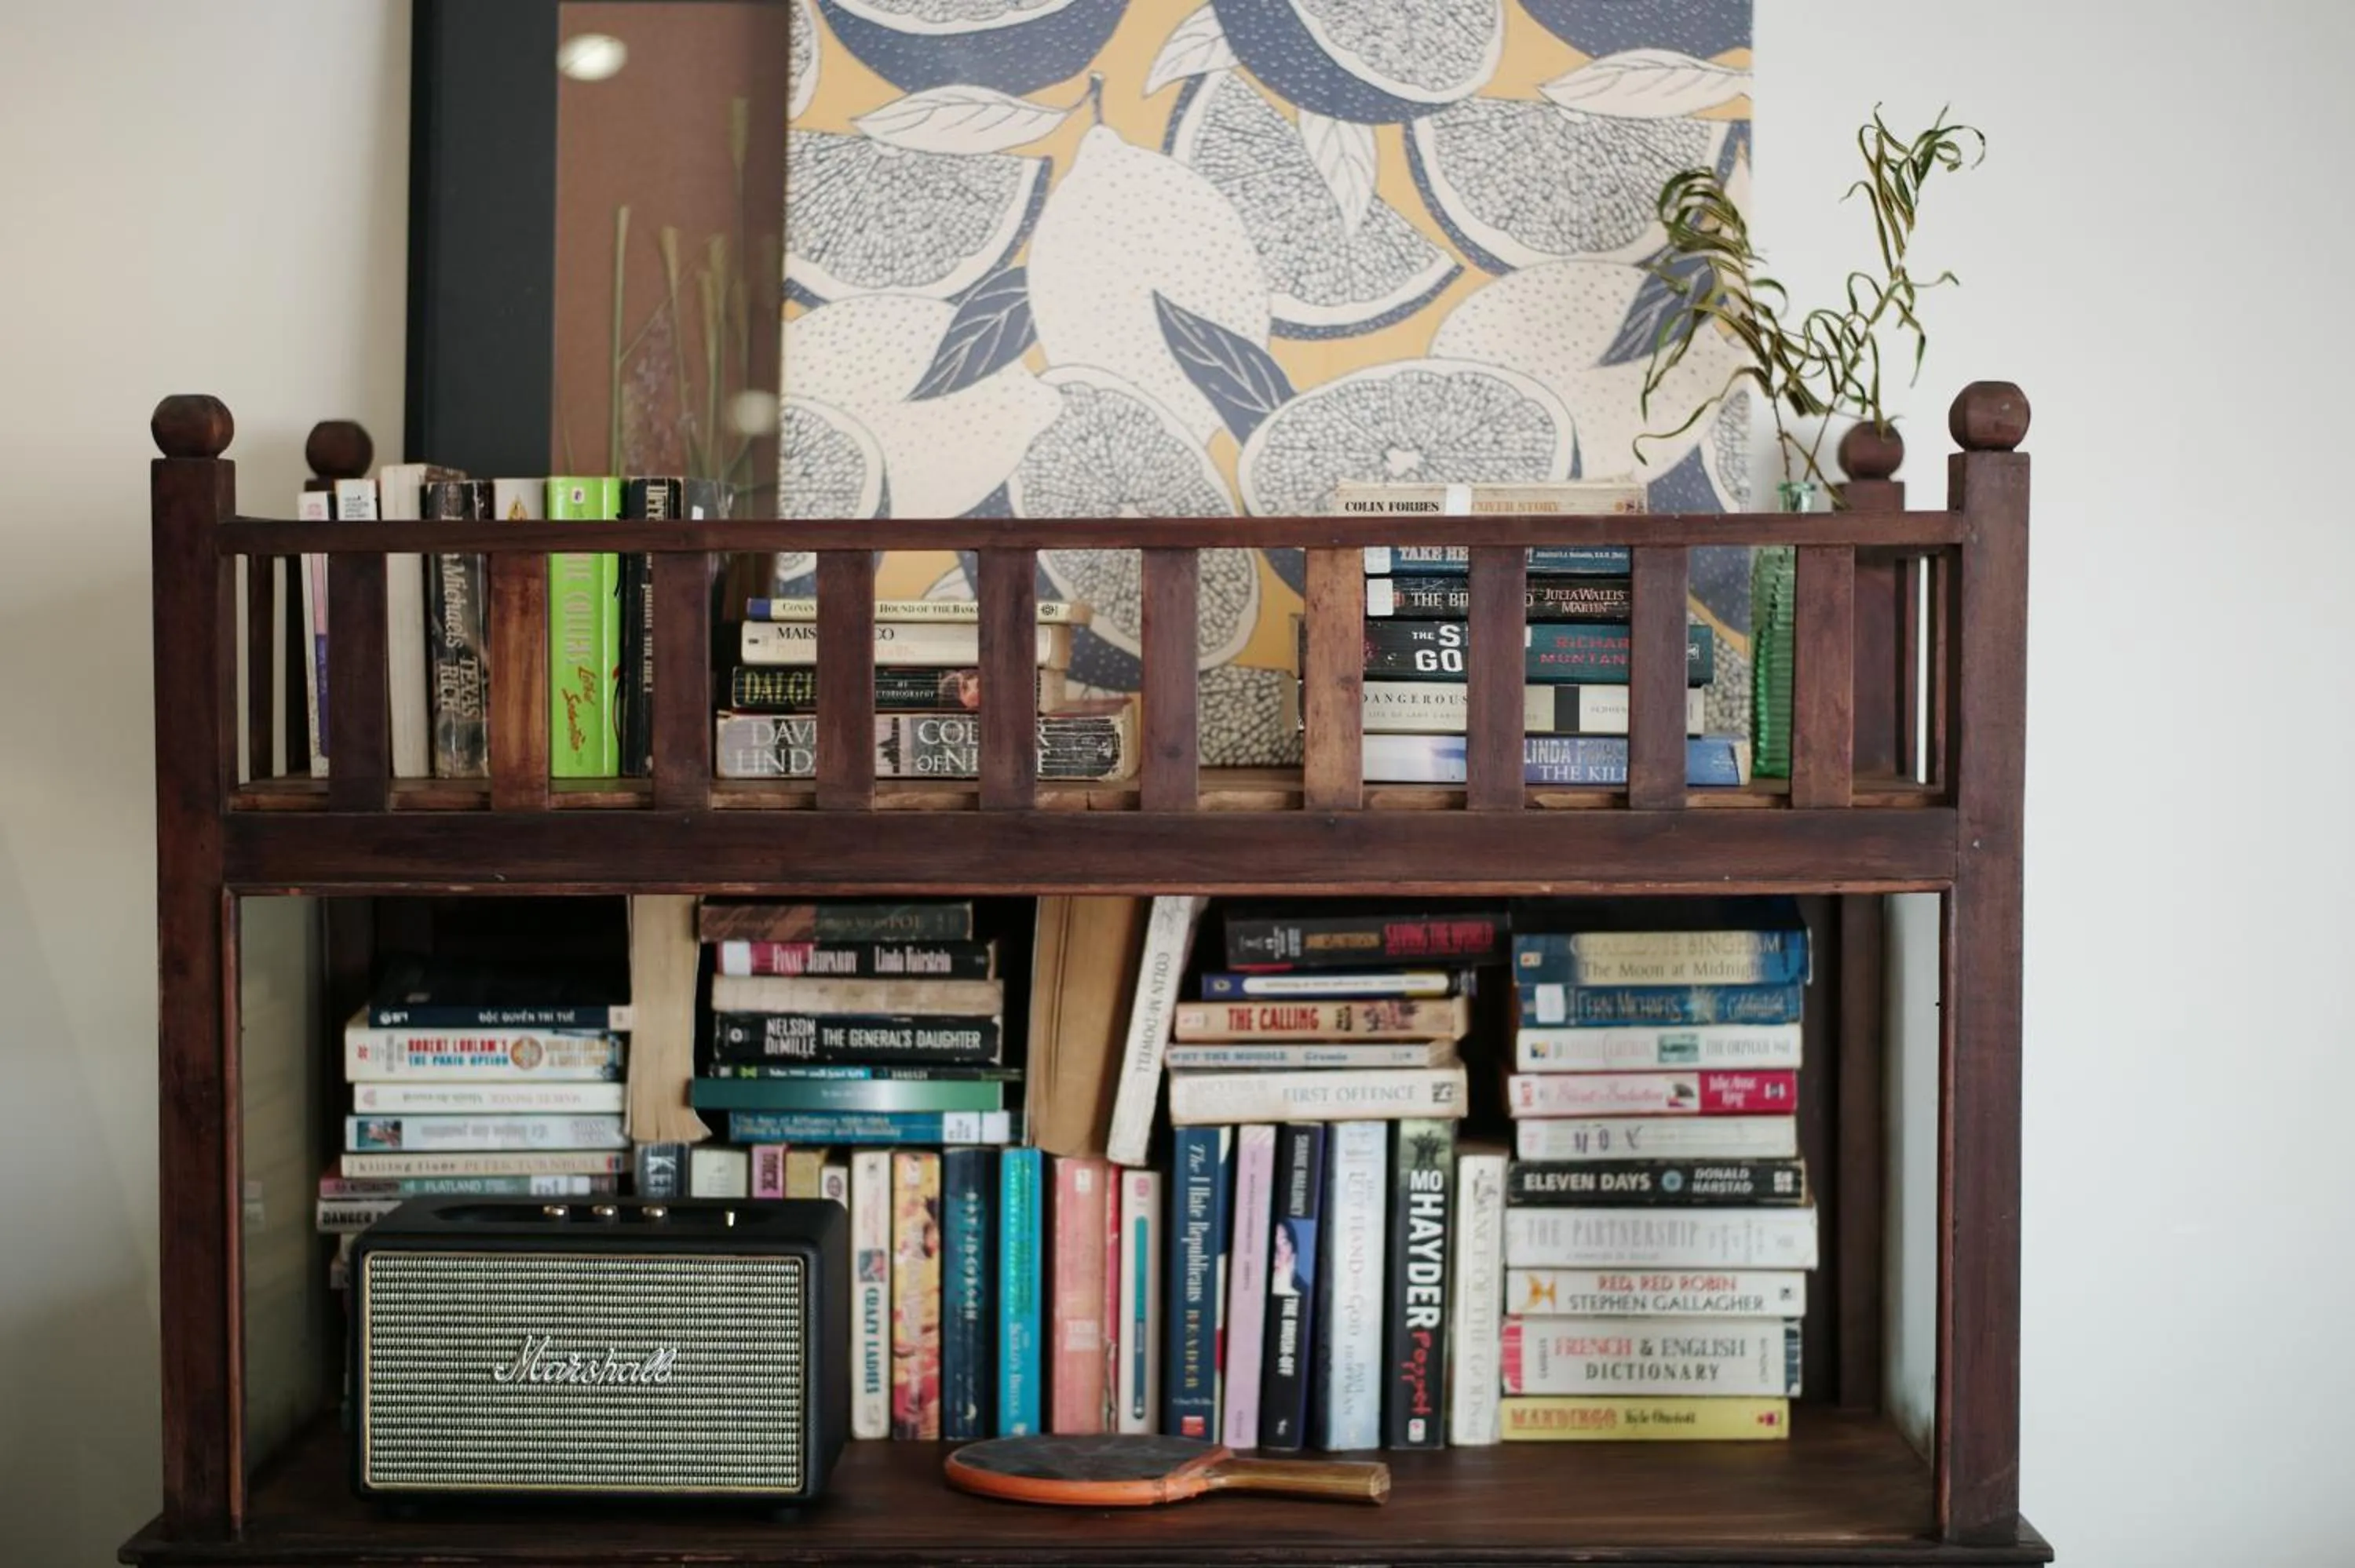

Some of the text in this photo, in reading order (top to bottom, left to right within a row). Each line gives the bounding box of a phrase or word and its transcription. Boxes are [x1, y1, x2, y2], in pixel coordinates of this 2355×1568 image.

[1345, 501, 1440, 512] COLIN FORBES
[1520, 501, 1561, 512] STORY
[1398, 546, 1443, 560] TAKE
[1411, 593, 1442, 607] THE
[1578, 588, 1625, 600] WALLIS
[443, 564, 469, 648] Michaels
[880, 603, 915, 613] HOUND
[933, 603, 949, 613] THE
[777, 626, 817, 640] MAIS
[1412, 632, 1436, 640] THE
[1557, 636, 1630, 648] RICHAR
[1539, 651, 1628, 665] MONTAN
[440, 665, 460, 712] RICH
[459, 657, 480, 717] TEXAS
[751, 720, 816, 746] DAVI
[1523, 740, 1571, 764] LINDA
[917, 754, 943, 772] OF
[1538, 766, 1581, 781] THE
[772, 943, 952, 974] FINAL JEOPARDY Linda Fairstein
[1150, 952, 1170, 995] COLIN
[1582, 962, 1612, 978] The
[1619, 963, 1665, 978] Moon
[1670, 964, 1684, 977] at
[765, 1018, 816, 1036] NELSON
[1227, 1007, 1320, 1031] THE CALLING
[821, 1028, 981, 1050] THE GENERAL'S DAUGHTER
[1283, 1085, 1417, 1103] FIRST OFFENCE
[1188, 1143, 1207, 1172] The
[1290, 1134, 1310, 1217] SHANE MALONEY
[1410, 1170, 1444, 1191] MO
[1523, 1172, 1652, 1191] ELEVEN DAYS
[1694, 1168, 1750, 1180] DONALD
[1692, 1180, 1754, 1194] HARSTAD
[1188, 1187, 1210, 1218] Hate
[323, 1212, 372, 1225] DANGER
[1572, 1218, 1700, 1248] PARTNERSHIP
[1349, 1215, 1365, 1274] HAND
[1180, 1221, 1210, 1303] Republicans
[1406, 1192, 1444, 1329] HAYDER
[1639, 1274, 1673, 1292] RED
[1678, 1274, 1737, 1292] ROBIN
[1569, 1293, 1764, 1312] STEPHEN GALLAGHER
[865, 1287, 880, 1395] CRAZY LADIES
[1278, 1297, 1299, 1377] THE BRUSH-OFF
[1554, 1337, 1746, 1358] FRENCH & ENGLISH
[1185, 1309, 1199, 1388] READER
[494, 1334, 677, 1385] Marshall
[1585, 1362, 1719, 1383] DICTIONARY
